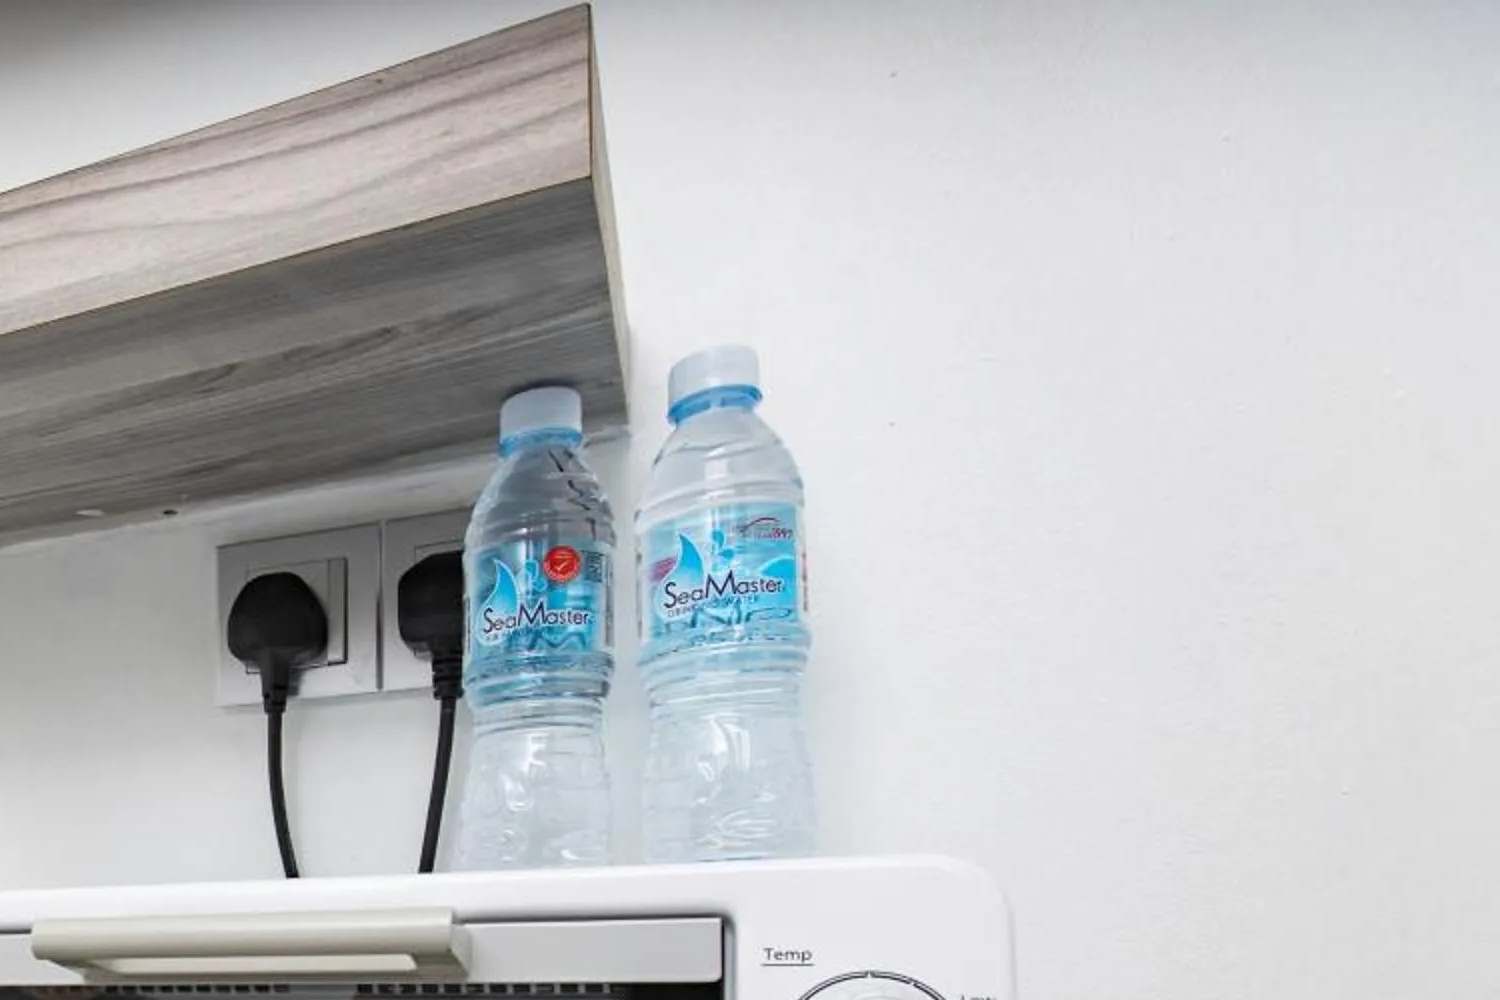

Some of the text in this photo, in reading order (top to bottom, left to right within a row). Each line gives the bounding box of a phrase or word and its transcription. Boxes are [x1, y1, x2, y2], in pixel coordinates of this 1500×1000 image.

[663, 569, 782, 609] SeaMaster
[483, 601, 589, 633] SeaMaster
[764, 948, 812, 962] Temp
